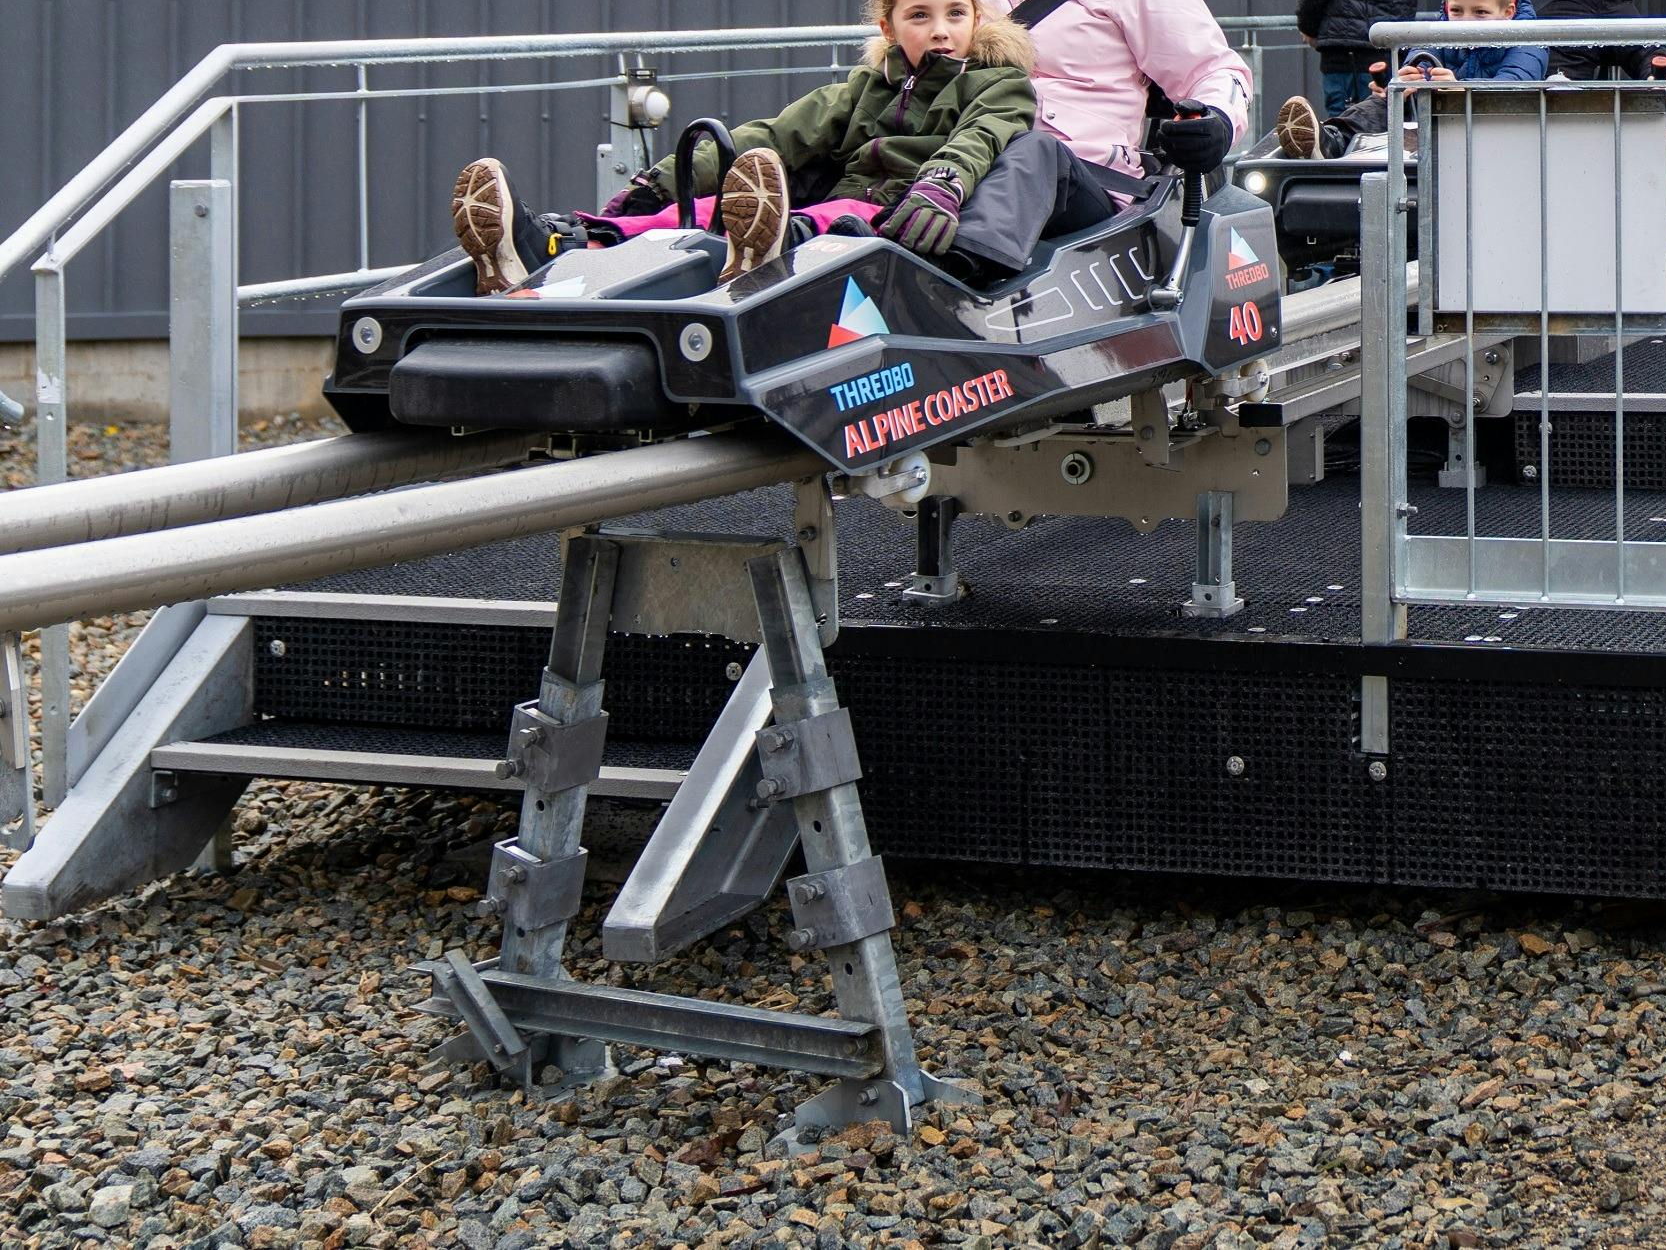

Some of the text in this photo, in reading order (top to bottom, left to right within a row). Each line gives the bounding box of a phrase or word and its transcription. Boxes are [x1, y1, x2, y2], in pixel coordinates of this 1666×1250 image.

[1225, 262, 1270, 291] THREDBO
[1229, 301, 1263, 346] 40
[829, 362, 915, 412] THREDBO
[843, 368, 1015, 459] ALPINE COASTER
